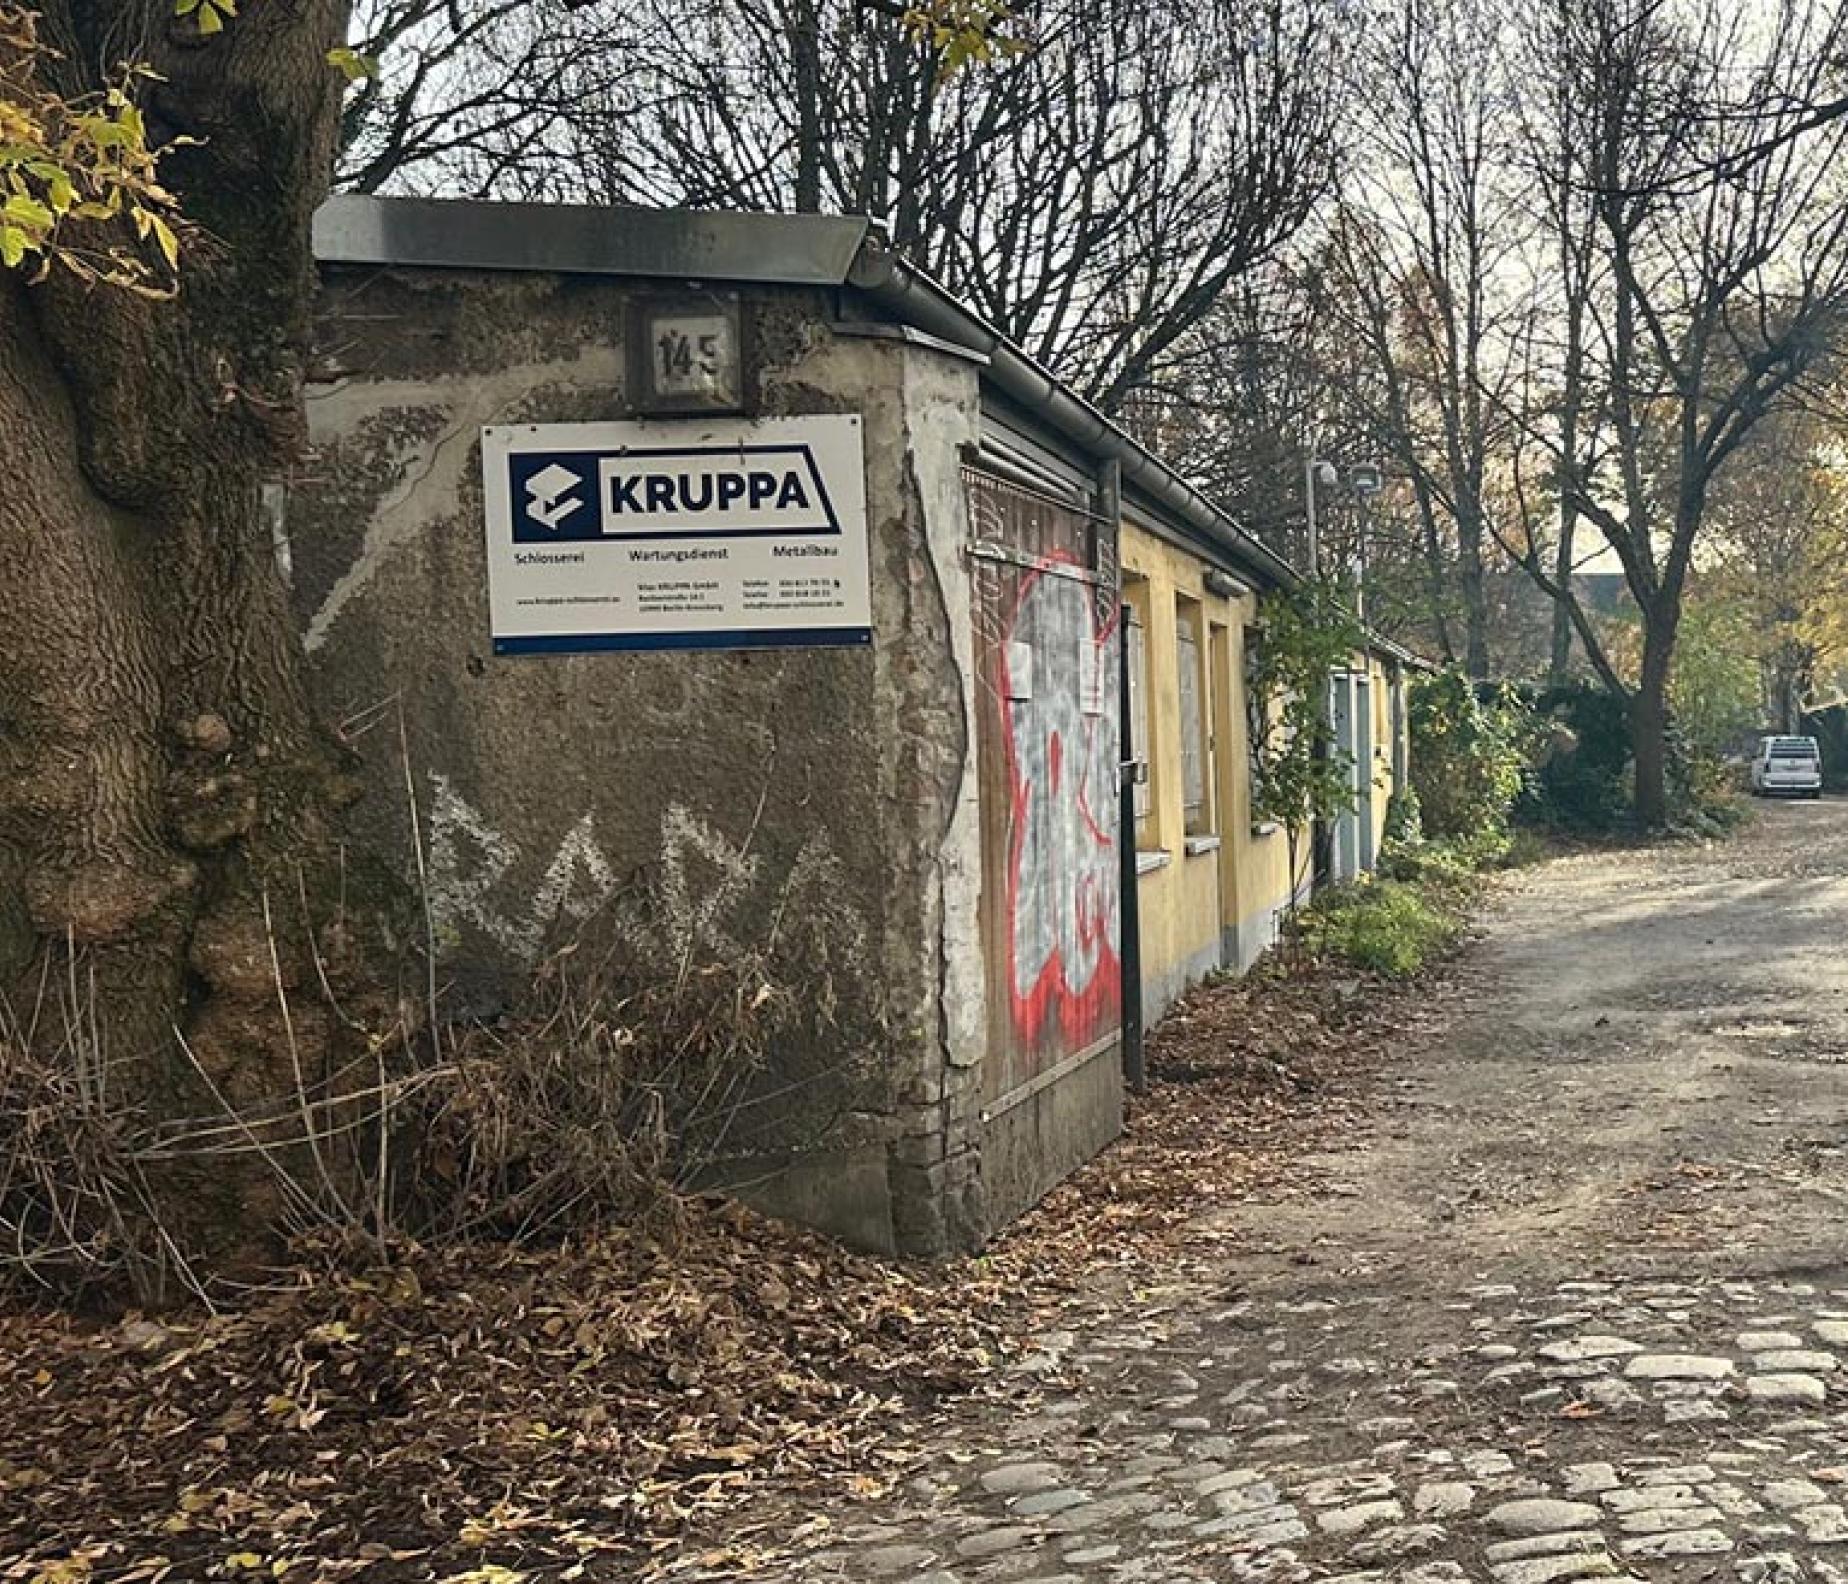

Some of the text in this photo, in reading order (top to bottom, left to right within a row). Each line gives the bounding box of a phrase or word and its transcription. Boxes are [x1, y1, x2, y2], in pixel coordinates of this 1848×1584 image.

[610, 471, 810, 515] KRUPPA
[513, 549, 586, 566] Schlosserei
[628, 546, 729, 562] Wartungsdienst
[771, 543, 839, 557] Metallbau
